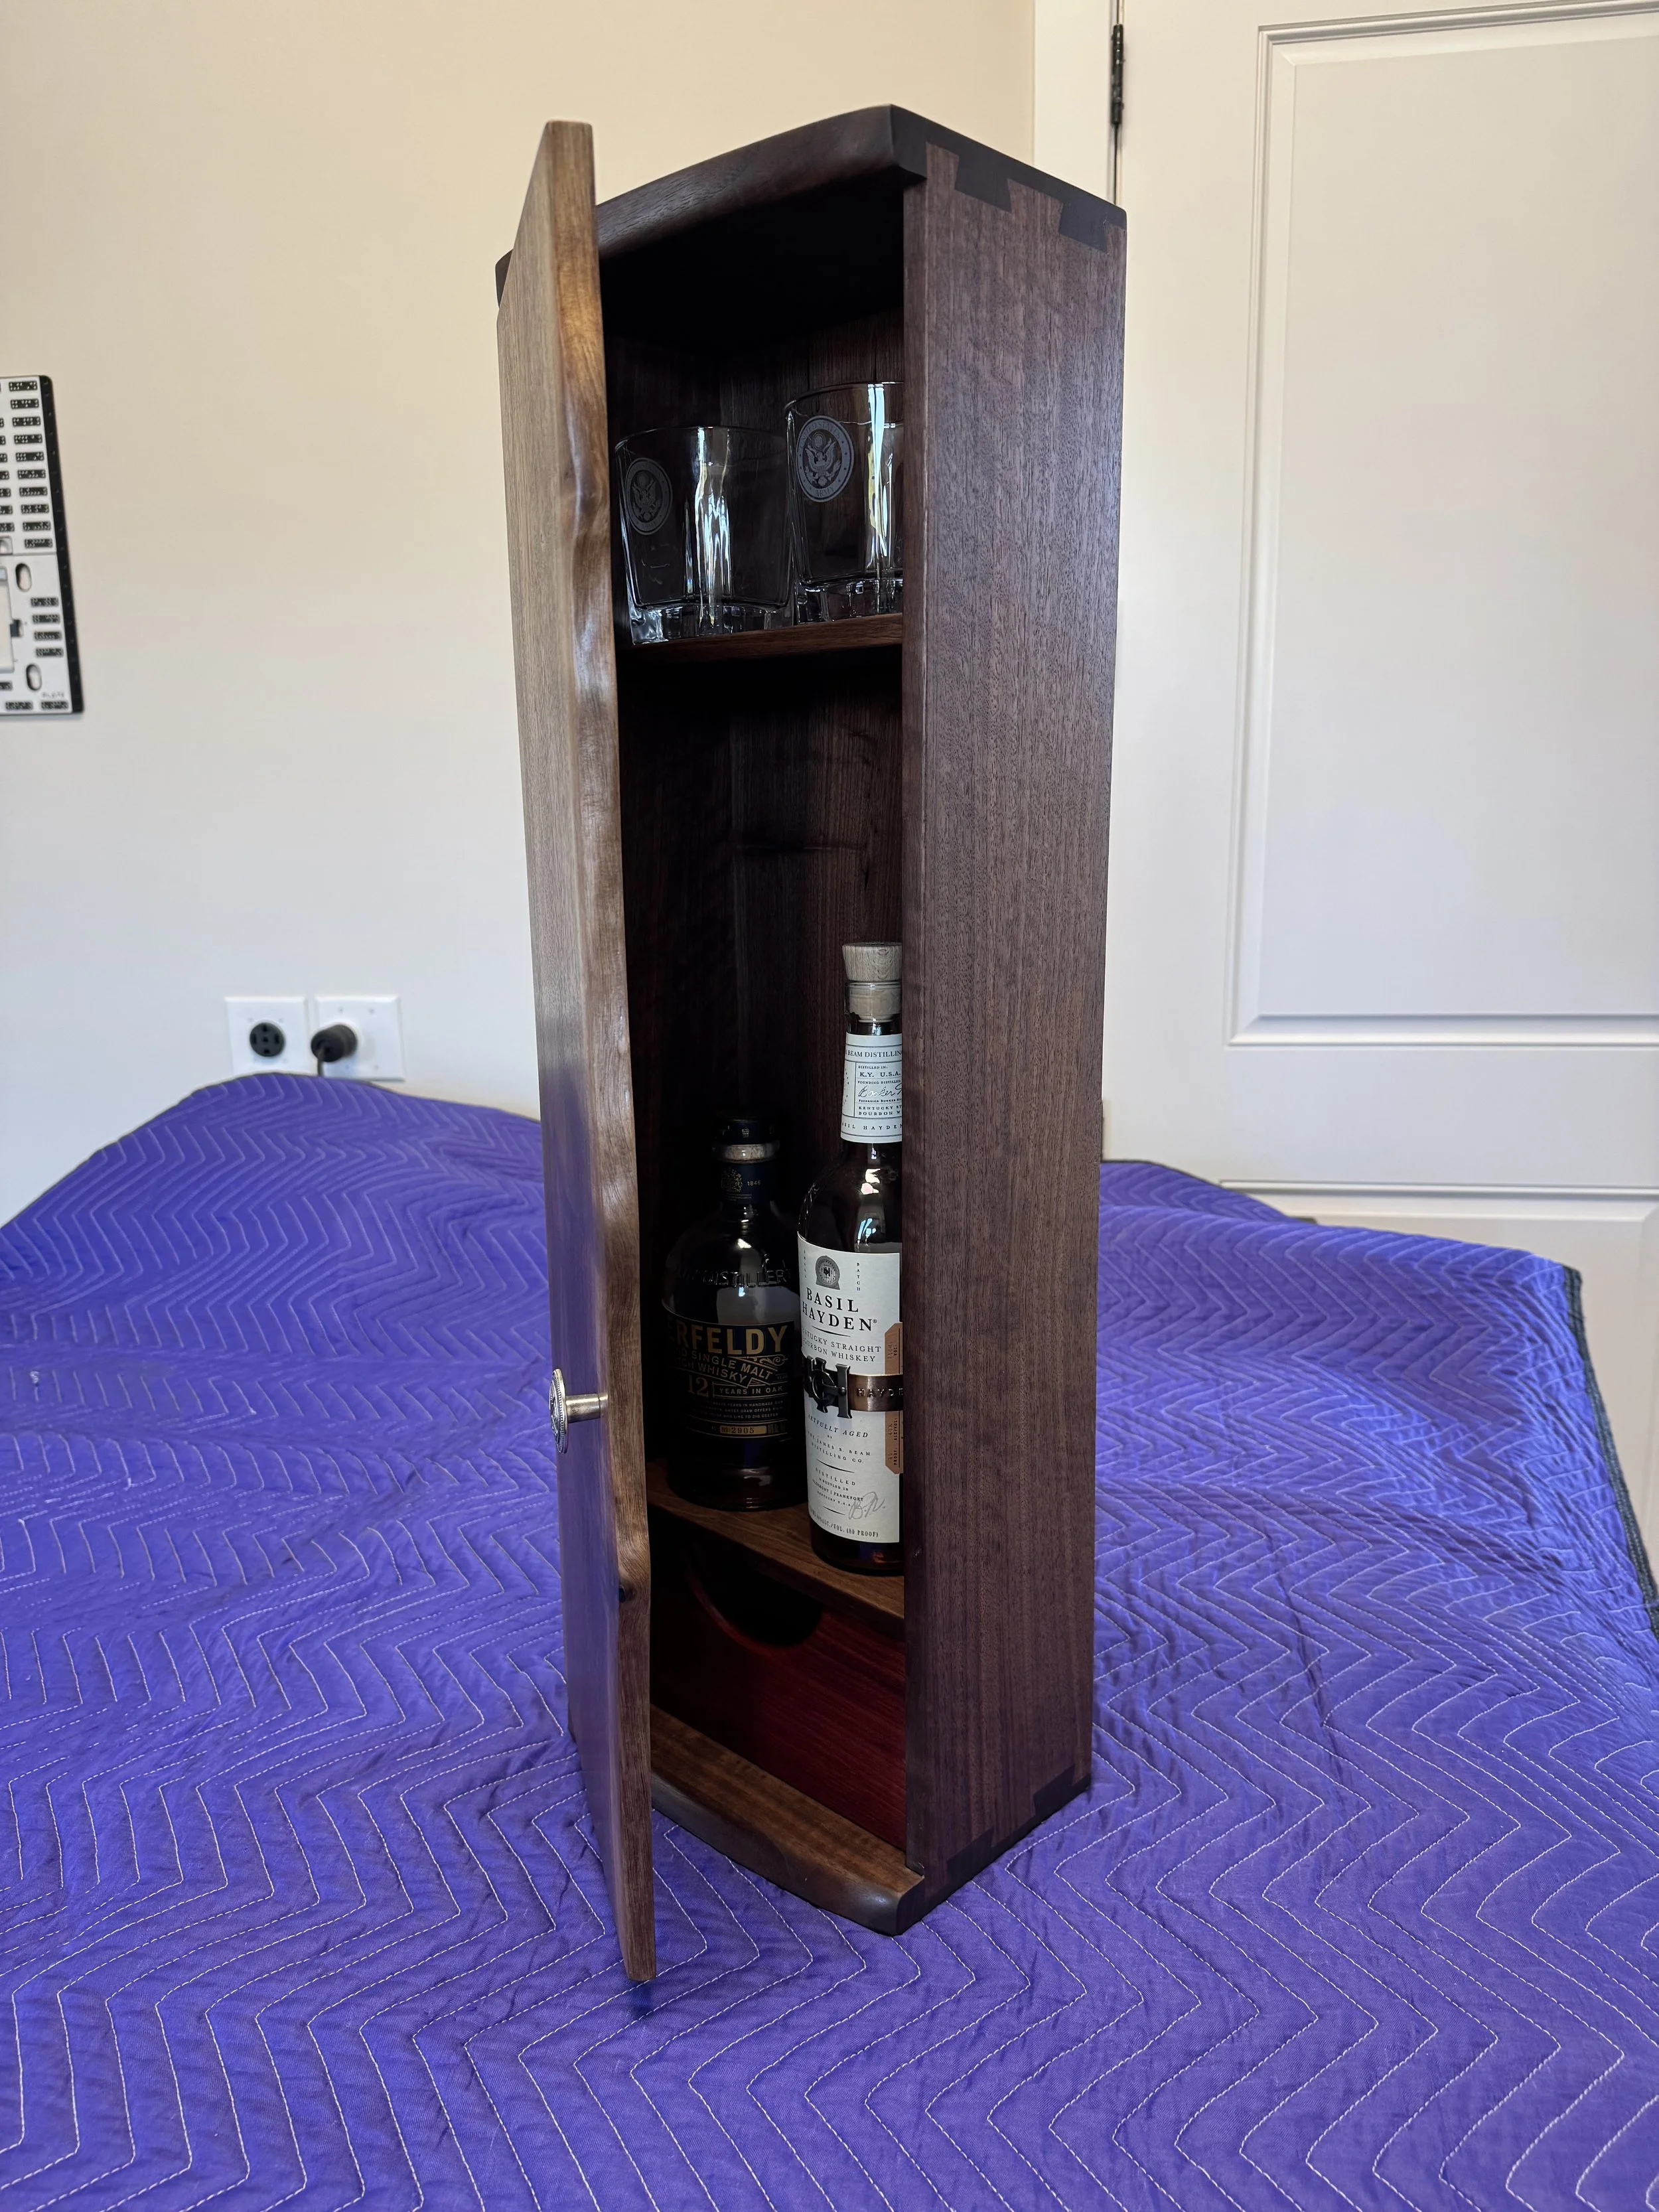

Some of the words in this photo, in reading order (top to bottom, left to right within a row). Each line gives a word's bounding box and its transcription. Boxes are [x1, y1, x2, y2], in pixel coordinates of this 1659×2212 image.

[806, 1287, 859, 1313] BASIL
[831, 1341, 881, 1353] STRAIGHT
[831, 1351, 876, 1362] WHISKEY
[691, 1350, 737, 1369] SINGLE
[741, 1363, 773, 1380] MALT
[697, 1363, 747, 1383] WHISKY
[687, 1374, 709, 1397] 12
[808, 1414, 839, 1433] ARTFULLY
[812, 1441, 847, 1460] DISTILLING
[817, 1438, 834, 1449] JAMES
[815, 1467, 856, 1486] DISTILLED
[833, 1491, 864, 1501] FRANKFORT
